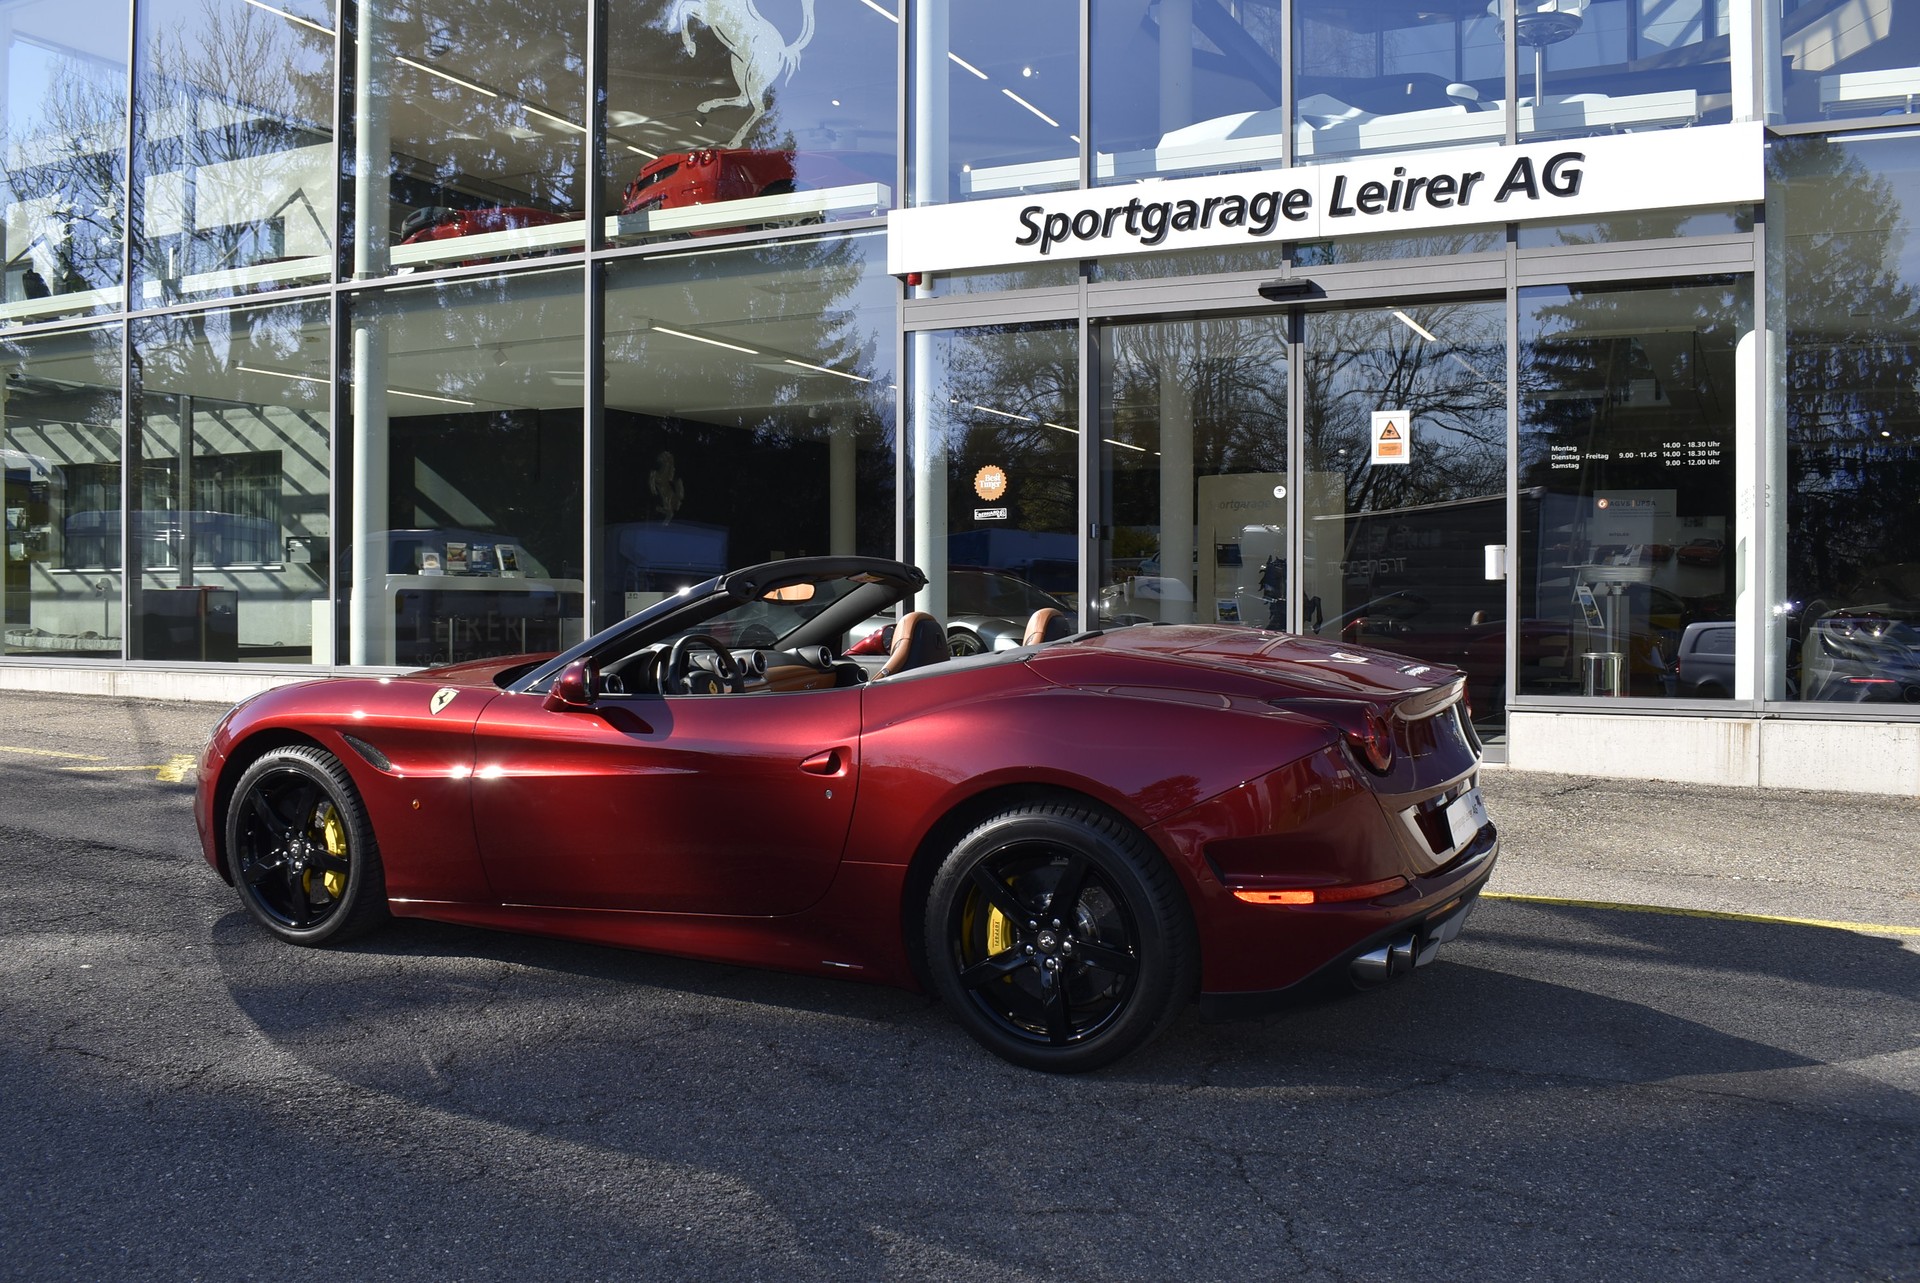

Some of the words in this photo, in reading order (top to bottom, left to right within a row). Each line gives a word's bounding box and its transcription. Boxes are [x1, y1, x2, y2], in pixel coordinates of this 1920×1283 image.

[1015, 184, 1311, 254] Sportgarage
[1328, 166, 1485, 219] Leirer
[1494, 151, 1586, 203] AG
